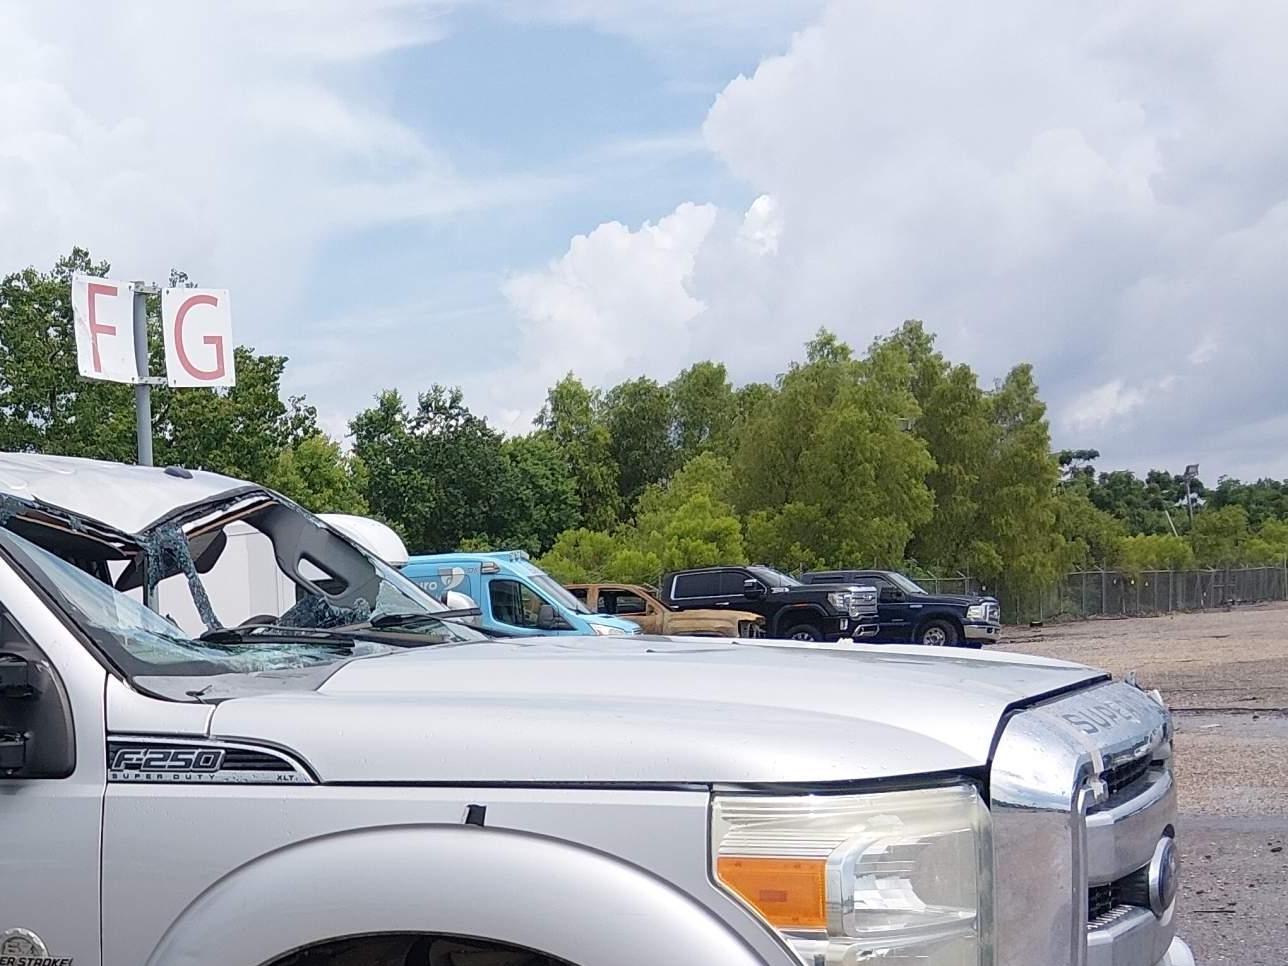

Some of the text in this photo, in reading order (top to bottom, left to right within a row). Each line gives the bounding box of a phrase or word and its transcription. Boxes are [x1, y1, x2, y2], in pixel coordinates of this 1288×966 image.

[88, 283, 225, 380] F G
[276, 774, 295, 782] XLT
